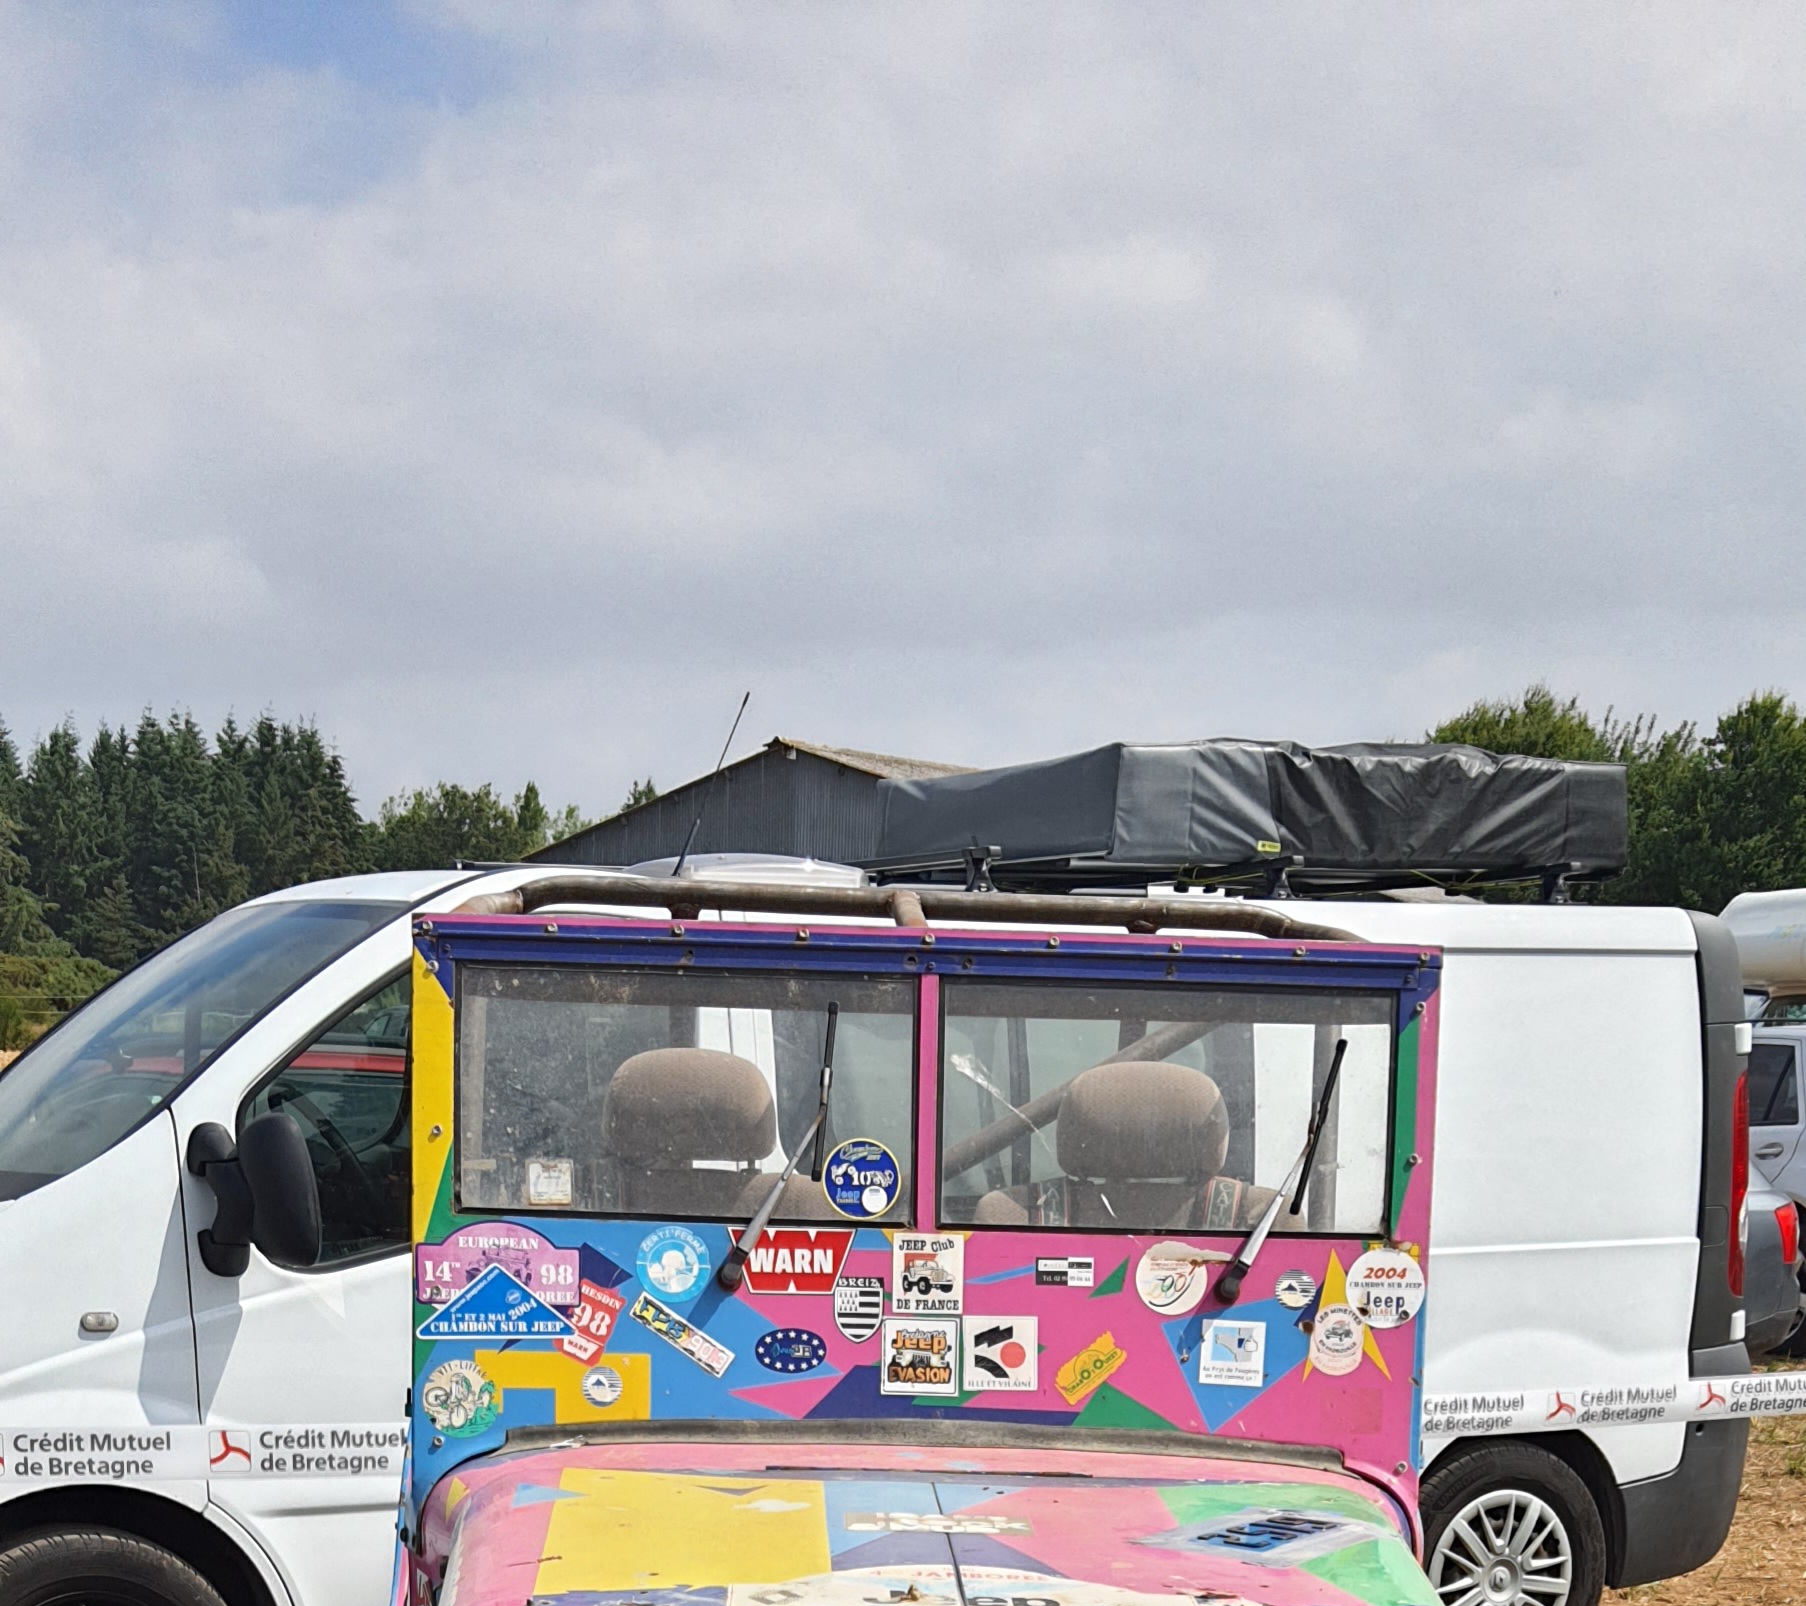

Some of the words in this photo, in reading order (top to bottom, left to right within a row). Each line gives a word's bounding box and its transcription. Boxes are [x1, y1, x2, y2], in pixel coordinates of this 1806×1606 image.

[459, 1236, 539, 1249] EUROPEAN
[899, 1239, 926, 1251] JEEP
[931, 1239, 955, 1253] Club
[750, 1248, 833, 1274] WARN
[540, 1264, 573, 1285] 98
[1363, 1267, 1408, 1279] 2004
[581, 1284, 622, 1310] HESDIN
[896, 1300, 910, 1309] DE
[915, 1300, 959, 1311] FRANCE
[1363, 1290, 1405, 1315] Jeep
[488, 1313, 506, 1321] MAI
[508, 1298, 538, 1320] 2004
[570, 1302, 611, 1336] 98
[430, 1321, 496, 1333] CHAMBON
[501, 1321, 528, 1333] SUR
[531, 1321, 565, 1333] JEEP
[567, 1339, 588, 1353] WARN
[891, 1330, 947, 1354] Jeep
[888, 1366, 951, 1383] EVASION
[1580, 1387, 1623, 1406] Crédit
[1627, 1384, 1677, 1404] Mutuel
[1731, 1378, 1772, 1395] Crédit
[1423, 1397, 1468, 1415] Crédit
[1472, 1394, 1524, 1413] Mutuel
[1580, 1407, 1598, 1423] de
[1601, 1405, 1665, 1423] Bretagne
[1730, 1399, 1747, 1413] de
[1423, 1416, 1442, 1432] de
[1446, 1415, 1513, 1433] Bretagne
[13, 1432, 84, 1452] Crédit
[90, 1431, 171, 1452] Mutuel
[259, 1429, 325, 1449] Crédit
[331, 1428, 407, 1448] Mutuel
[14, 1456, 43, 1476] de
[49, 1457, 154, 1479] Bretagne
[260, 1452, 287, 1472] de
[292, 1453, 389, 1474] Bretagne
